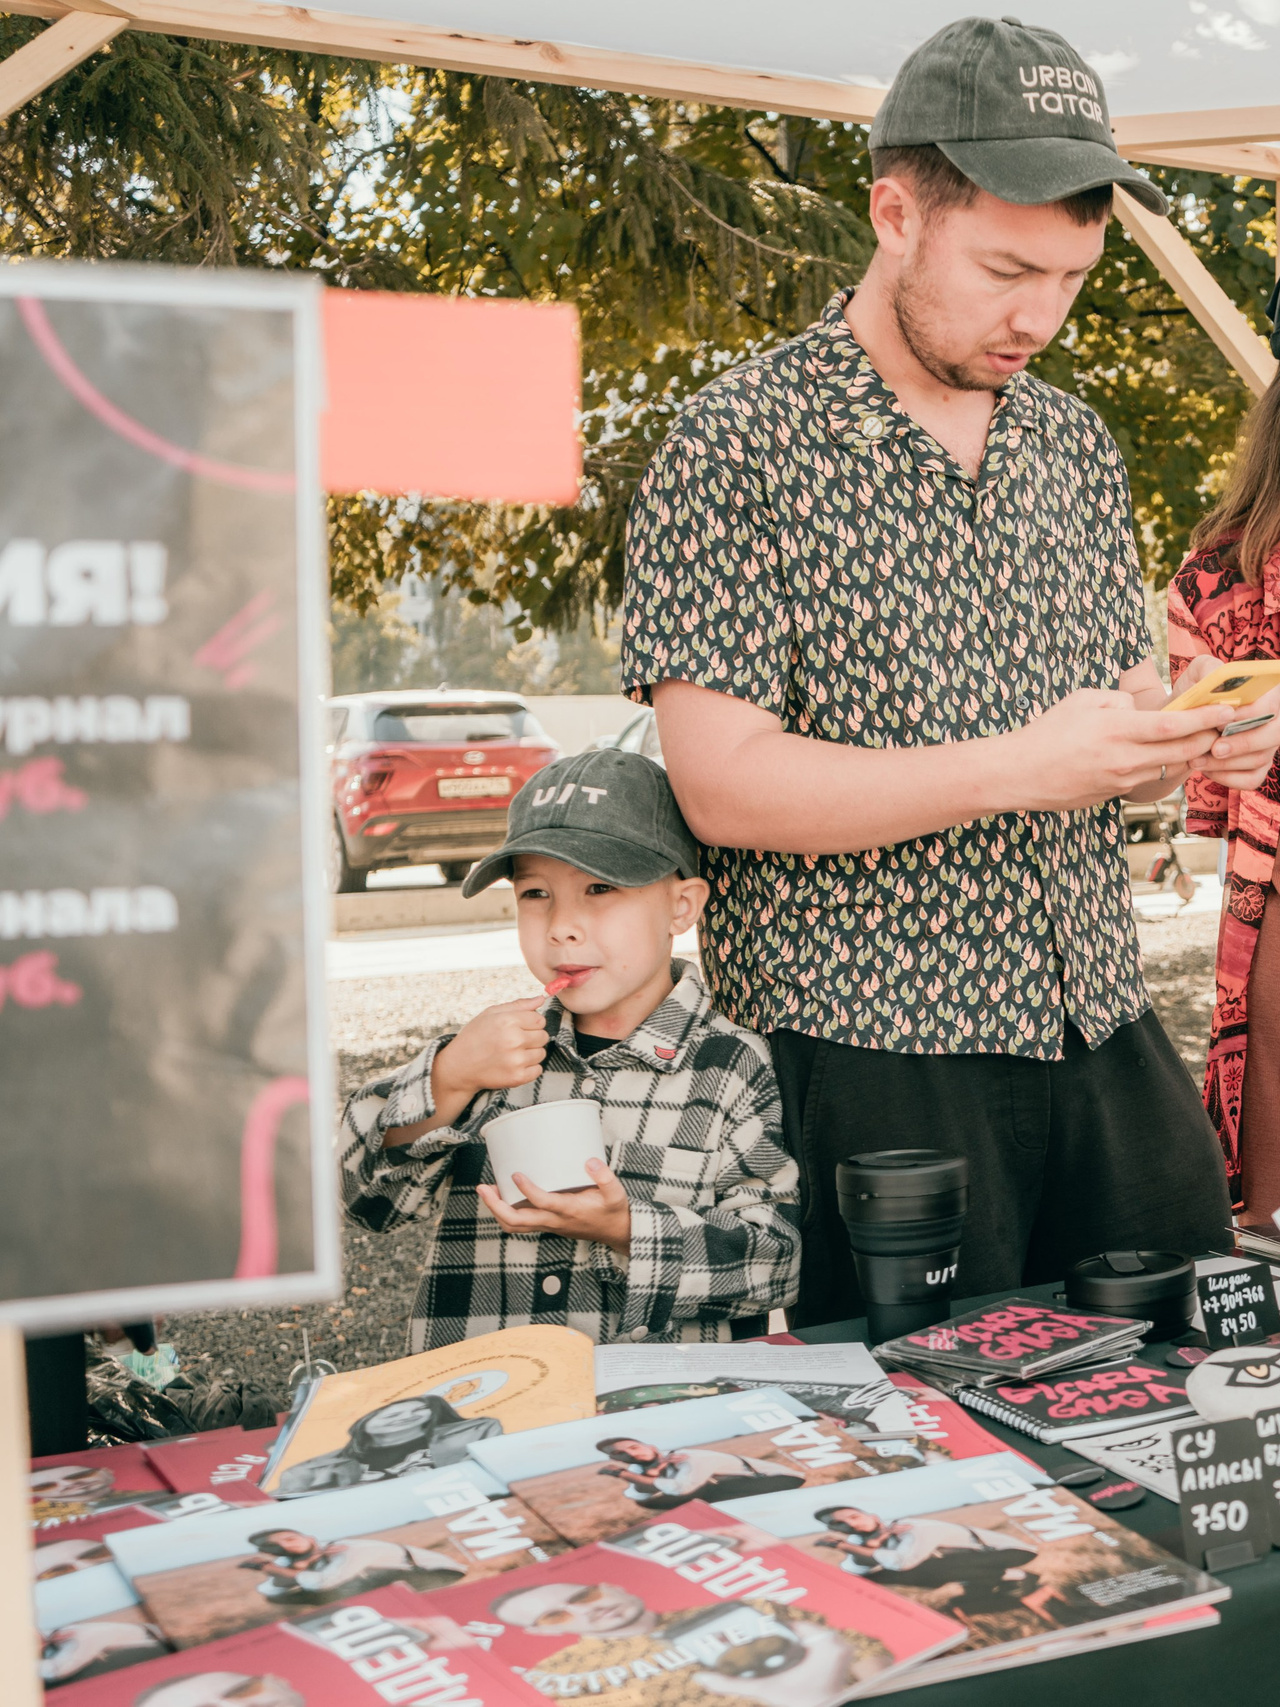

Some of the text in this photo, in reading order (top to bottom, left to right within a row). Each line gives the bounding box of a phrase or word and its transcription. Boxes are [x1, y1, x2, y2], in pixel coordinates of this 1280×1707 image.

[1019, 65, 1099, 98] URBAN
[1022, 91, 1104, 124] TATAR
[0, 695, 191, 755] рнал
[532, 783, 608, 807] U/T
[1190, 1499, 1249, 1536] 750
